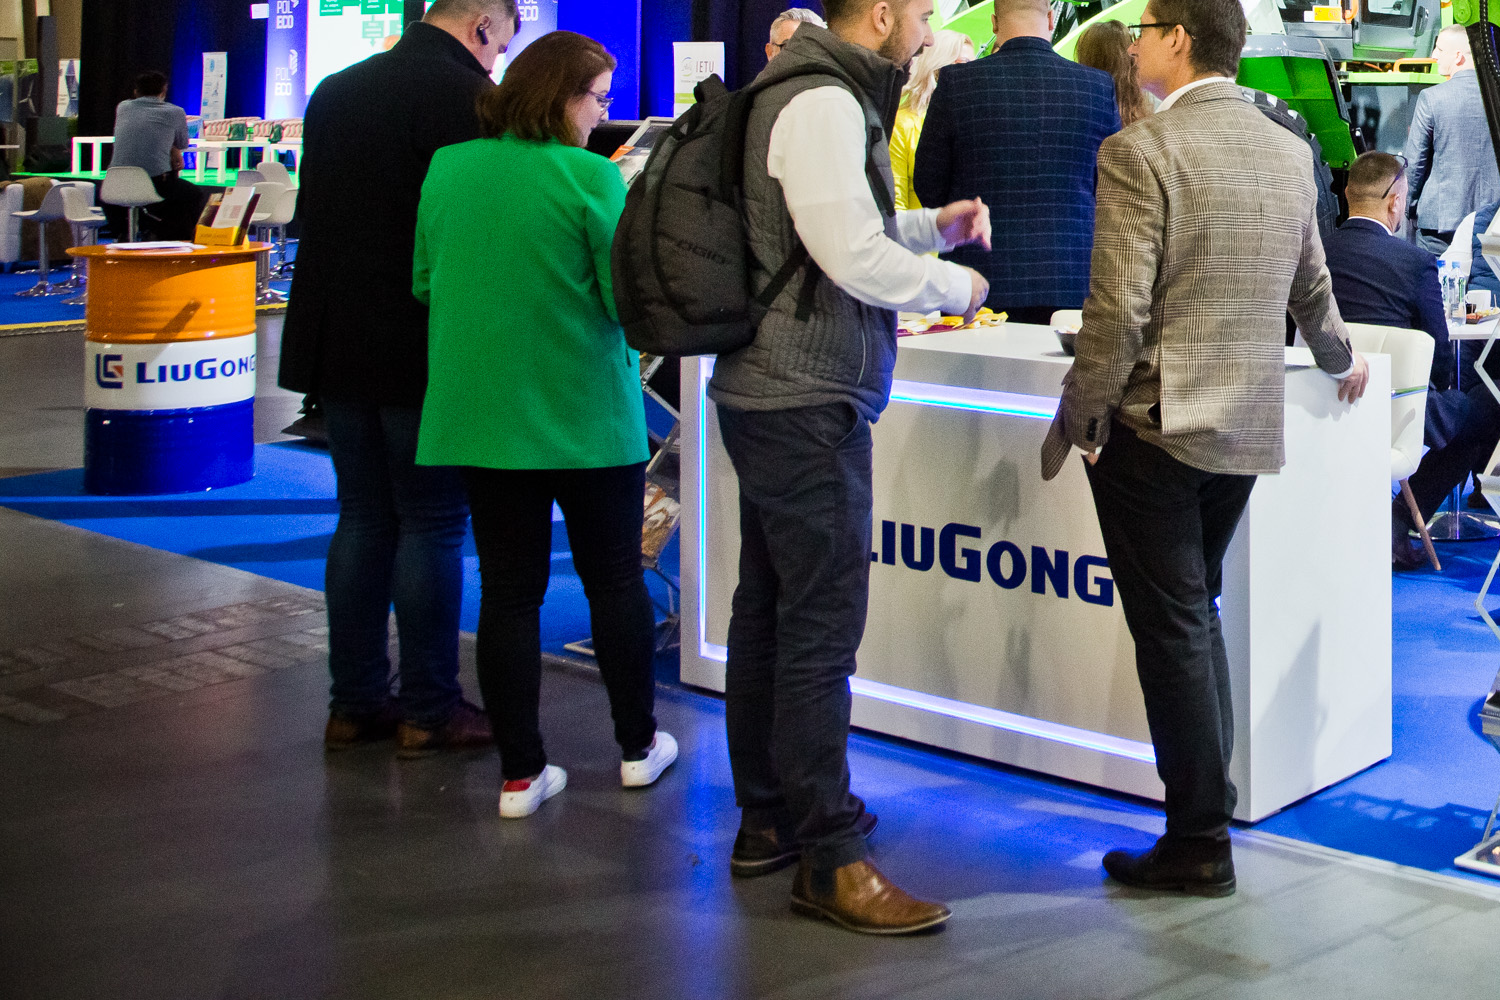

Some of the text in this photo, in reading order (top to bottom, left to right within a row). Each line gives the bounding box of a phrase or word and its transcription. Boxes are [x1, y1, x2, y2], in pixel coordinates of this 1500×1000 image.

[276, 0, 293, 15] POL
[276, 14, 294, 29] ECO
[695, 60, 715, 74] IETU
